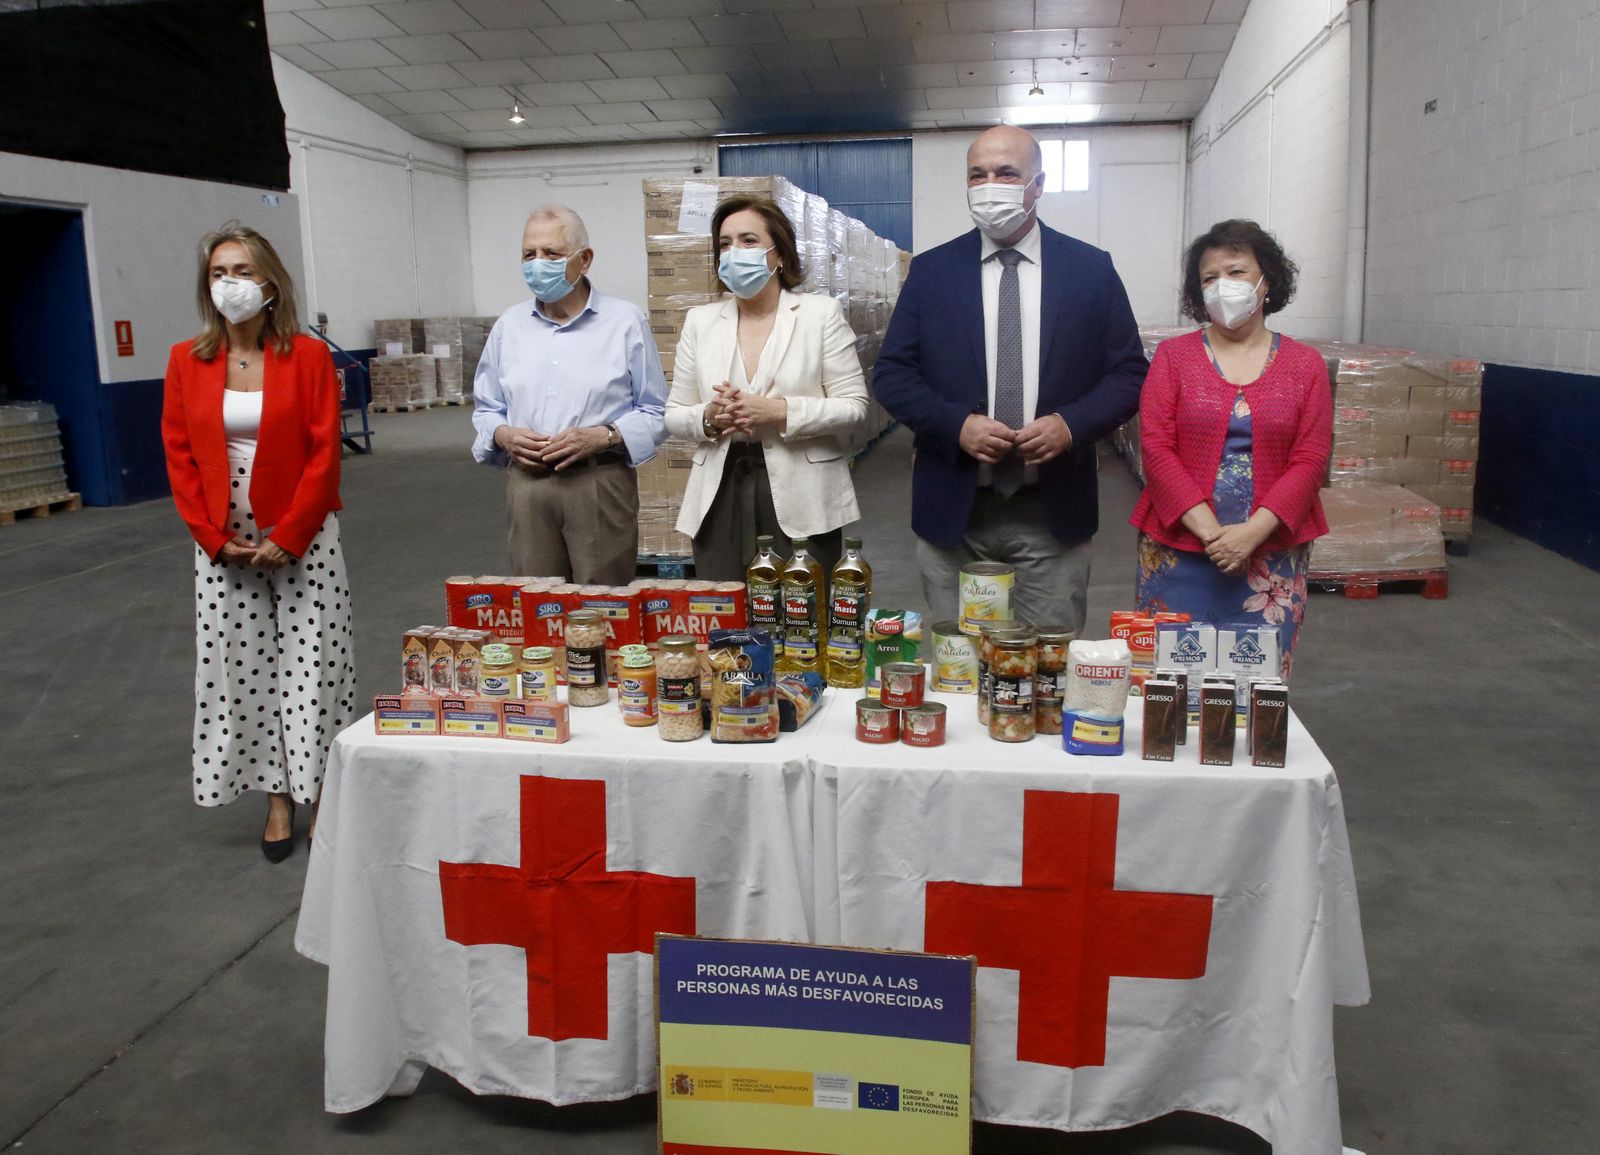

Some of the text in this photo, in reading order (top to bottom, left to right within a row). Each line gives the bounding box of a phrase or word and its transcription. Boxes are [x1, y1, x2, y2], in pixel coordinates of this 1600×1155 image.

[468, 594, 492, 606] SIRO
[646, 599, 669, 611] SIRO
[538, 603, 562, 616] SIRO
[477, 608, 524, 627] MAR
[786, 618, 810, 626] Sumum
[832, 616, 857, 626] Sumum
[655, 614, 721, 634] MARIA
[1116, 628, 1130, 639] ap
[1135, 634, 1155, 646] api
[876, 644, 900, 652] Arroz
[1233, 656, 1262, 664] PRIMOR
[1076, 665, 1126, 678] ORIENTE
[1146, 694, 1174, 702] GRESSO
[1204, 698, 1232, 706] GRESSO
[1256, 699, 1285, 708] GRESSO
[696, 963, 919, 991] PROGRAMA DE AYUDA A LAS
[677, 980, 944, 1010] PERSONAS MÁS DESFAVORECIDAS
[903, 1106, 958, 1117] DESFAVORECIDAS
